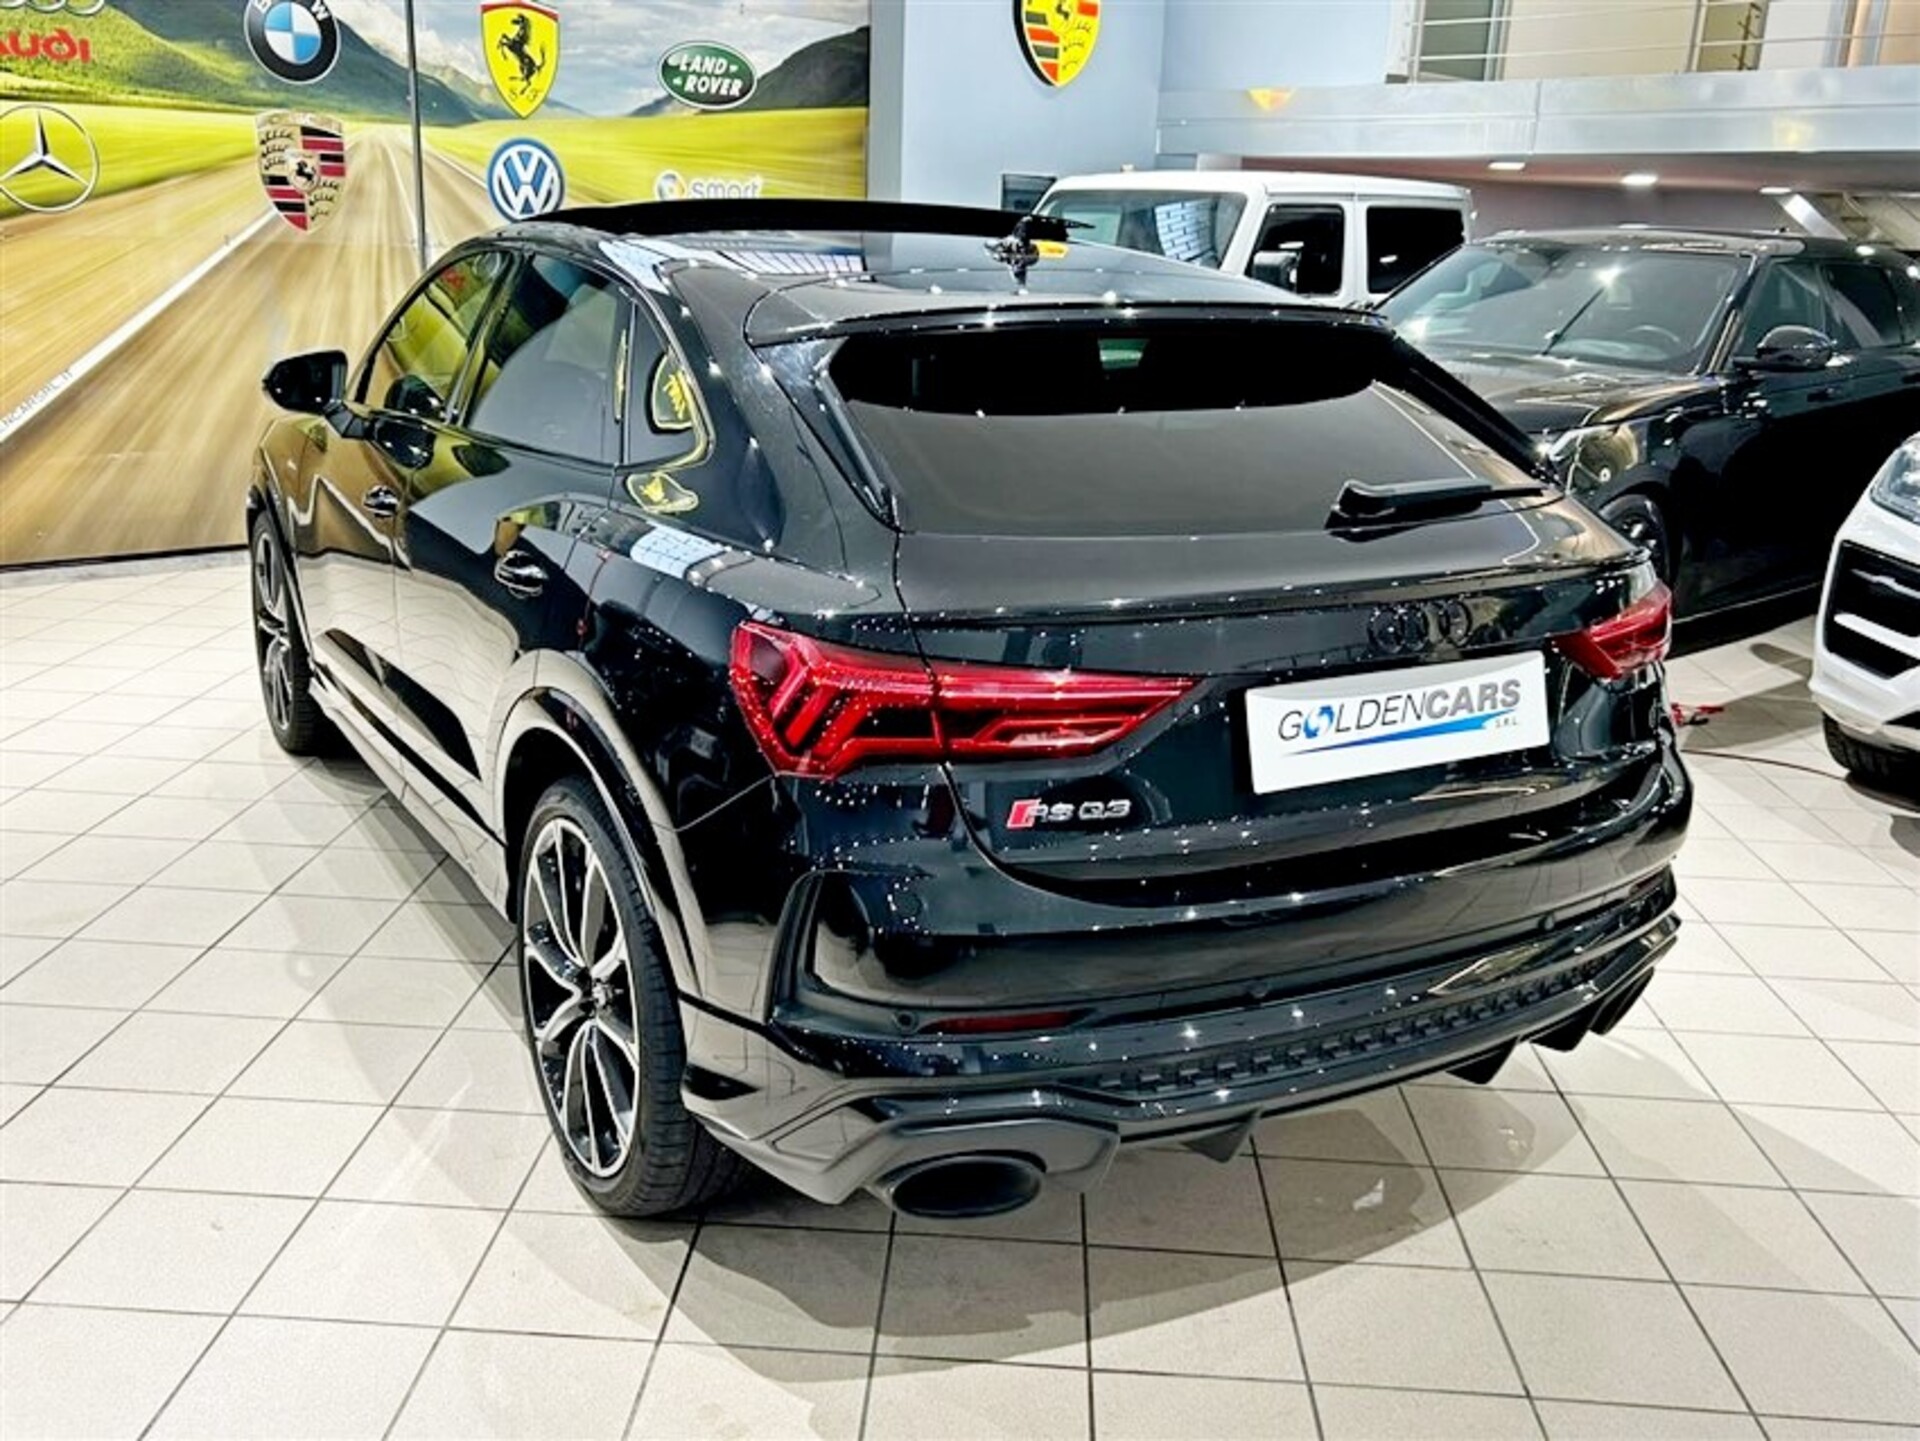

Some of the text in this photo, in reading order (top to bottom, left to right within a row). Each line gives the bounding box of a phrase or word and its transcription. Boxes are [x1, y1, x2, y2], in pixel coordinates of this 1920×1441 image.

[679, 54, 728, 75] LAND
[685, 75, 742, 96] ROVER
[1278, 679, 1521, 741] GOLDENCARS
[1018, 799, 1131, 825] RS Q3
